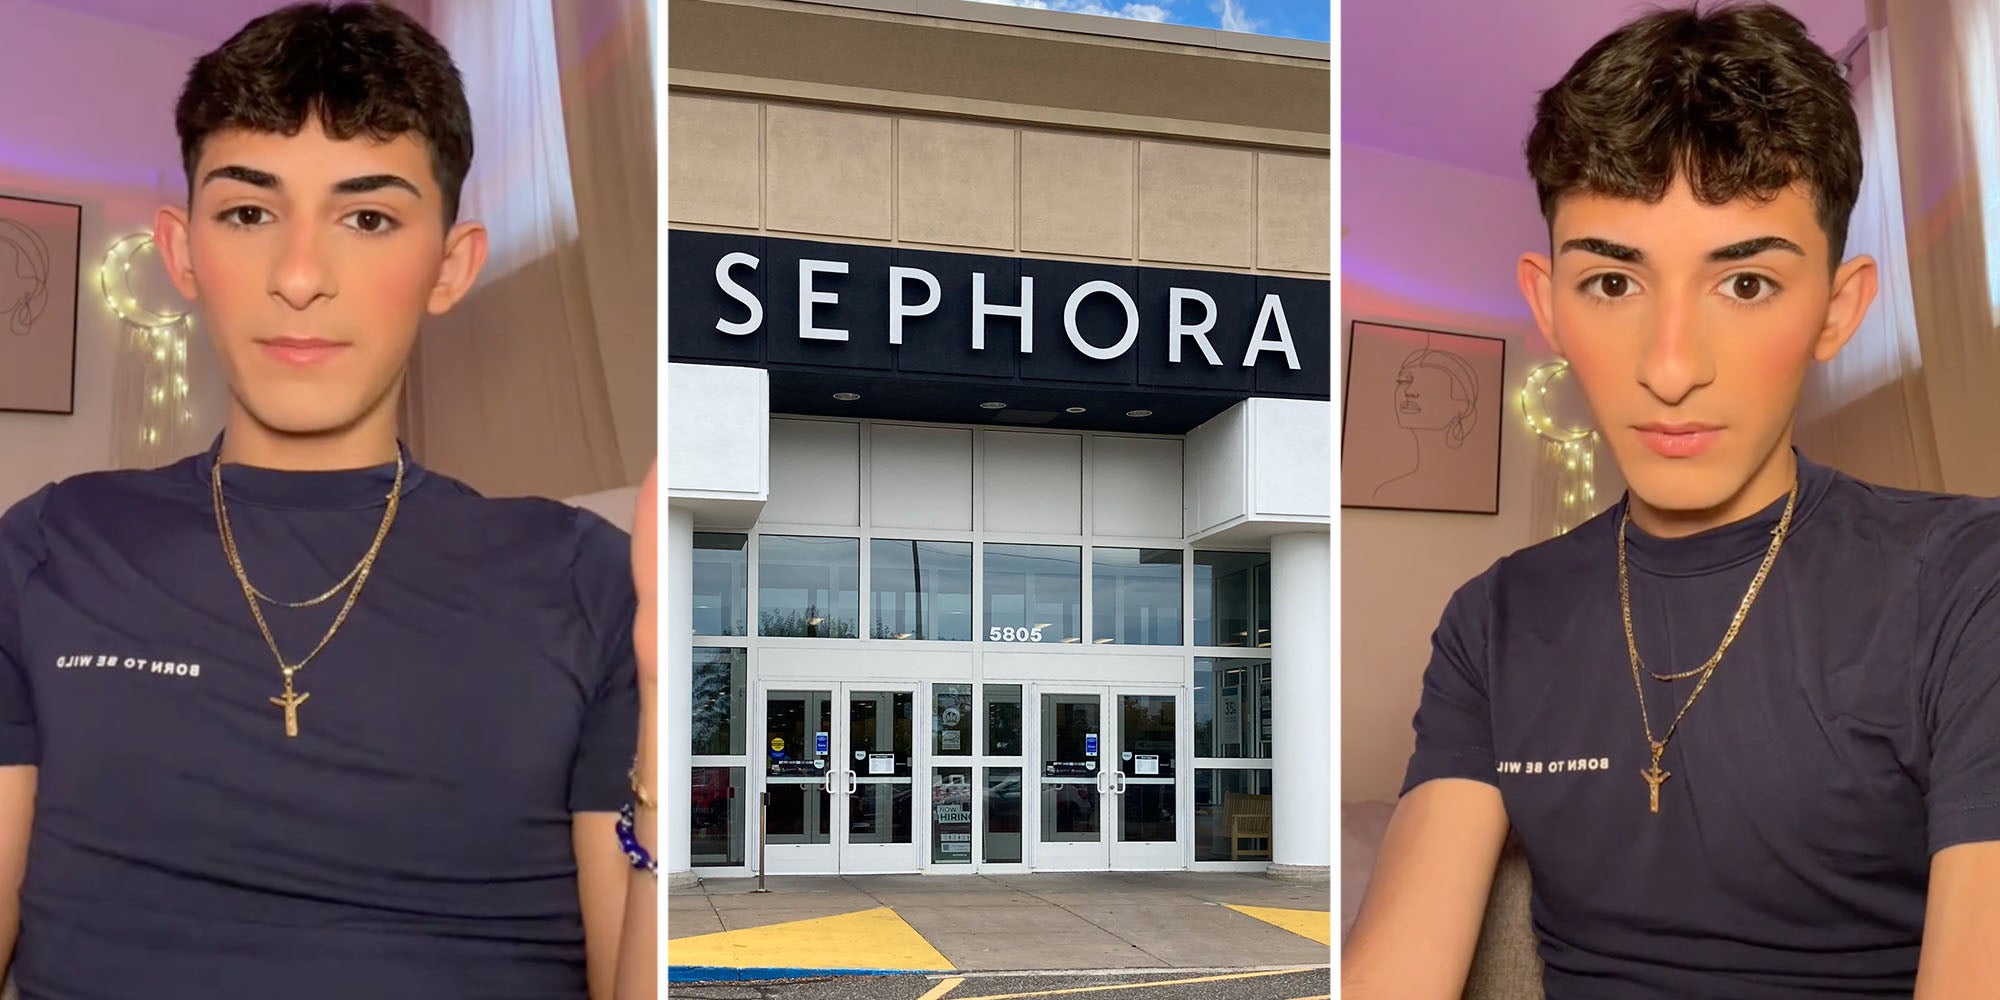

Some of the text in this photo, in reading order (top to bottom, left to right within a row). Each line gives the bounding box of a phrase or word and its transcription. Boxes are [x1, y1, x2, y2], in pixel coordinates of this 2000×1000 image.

[715, 251, 1301, 370] SEPHORA
[989, 626, 1042, 642] 5805
[940, 813, 970, 821] HIRIN
